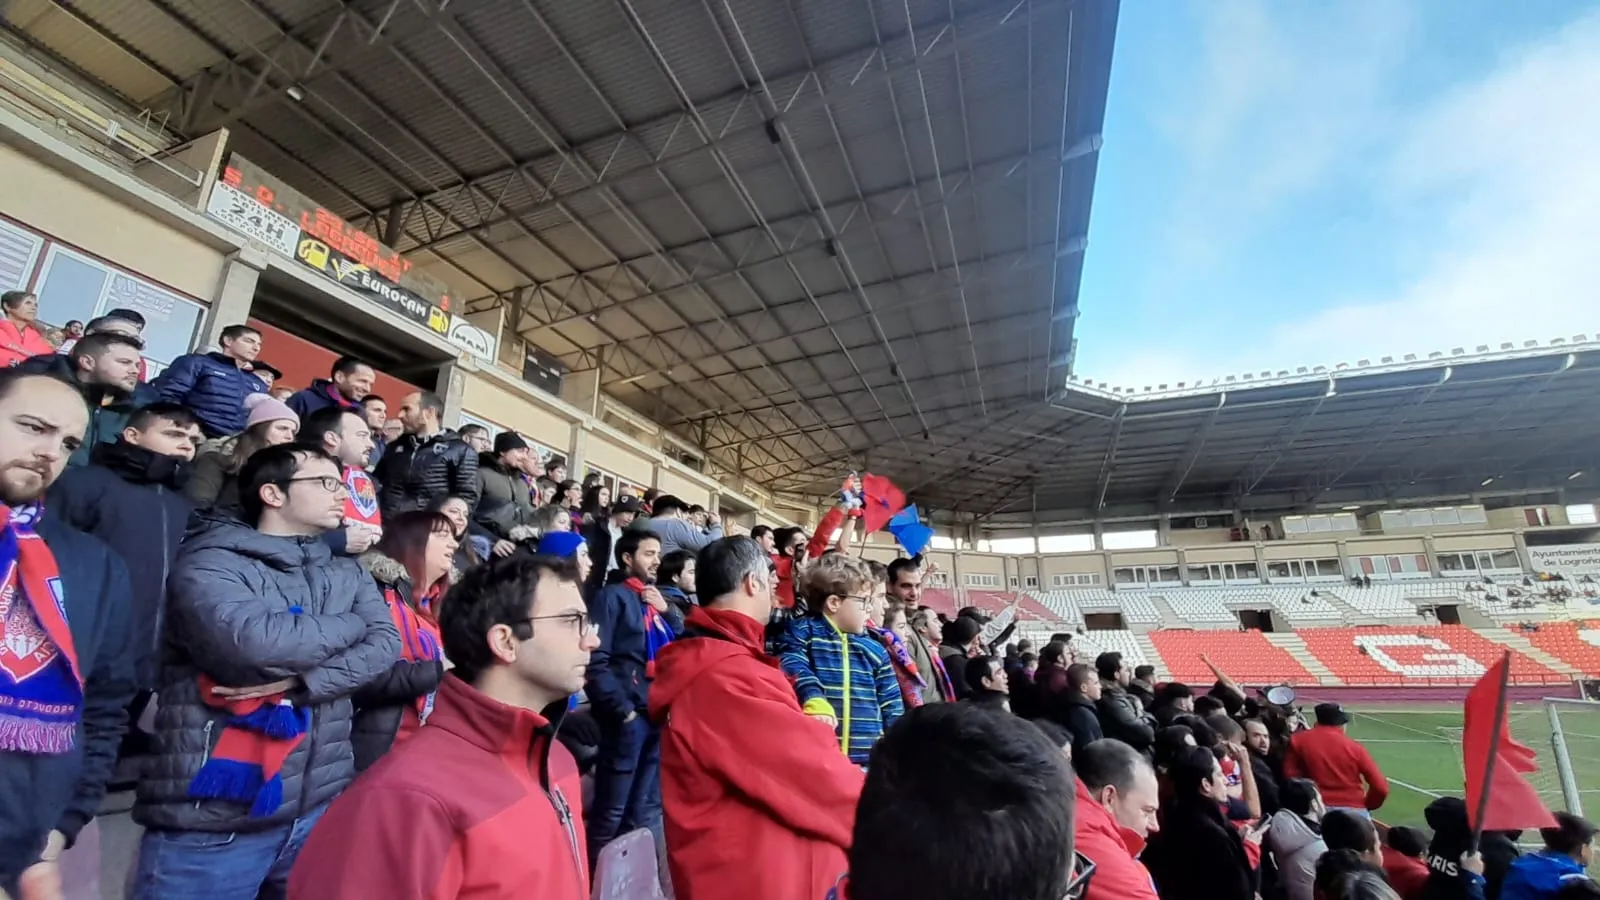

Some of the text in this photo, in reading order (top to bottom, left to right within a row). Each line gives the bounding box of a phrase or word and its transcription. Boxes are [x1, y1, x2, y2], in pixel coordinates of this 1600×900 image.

[220, 183, 299, 231] GASOLINERA
[230, 203, 284, 239] 24H
[232, 197, 286, 229] ABIERTA
[361, 275, 427, 318] EUROCAM
[455, 332, 485, 354] MAN
[1560, 557, 1600, 567] Logroño
